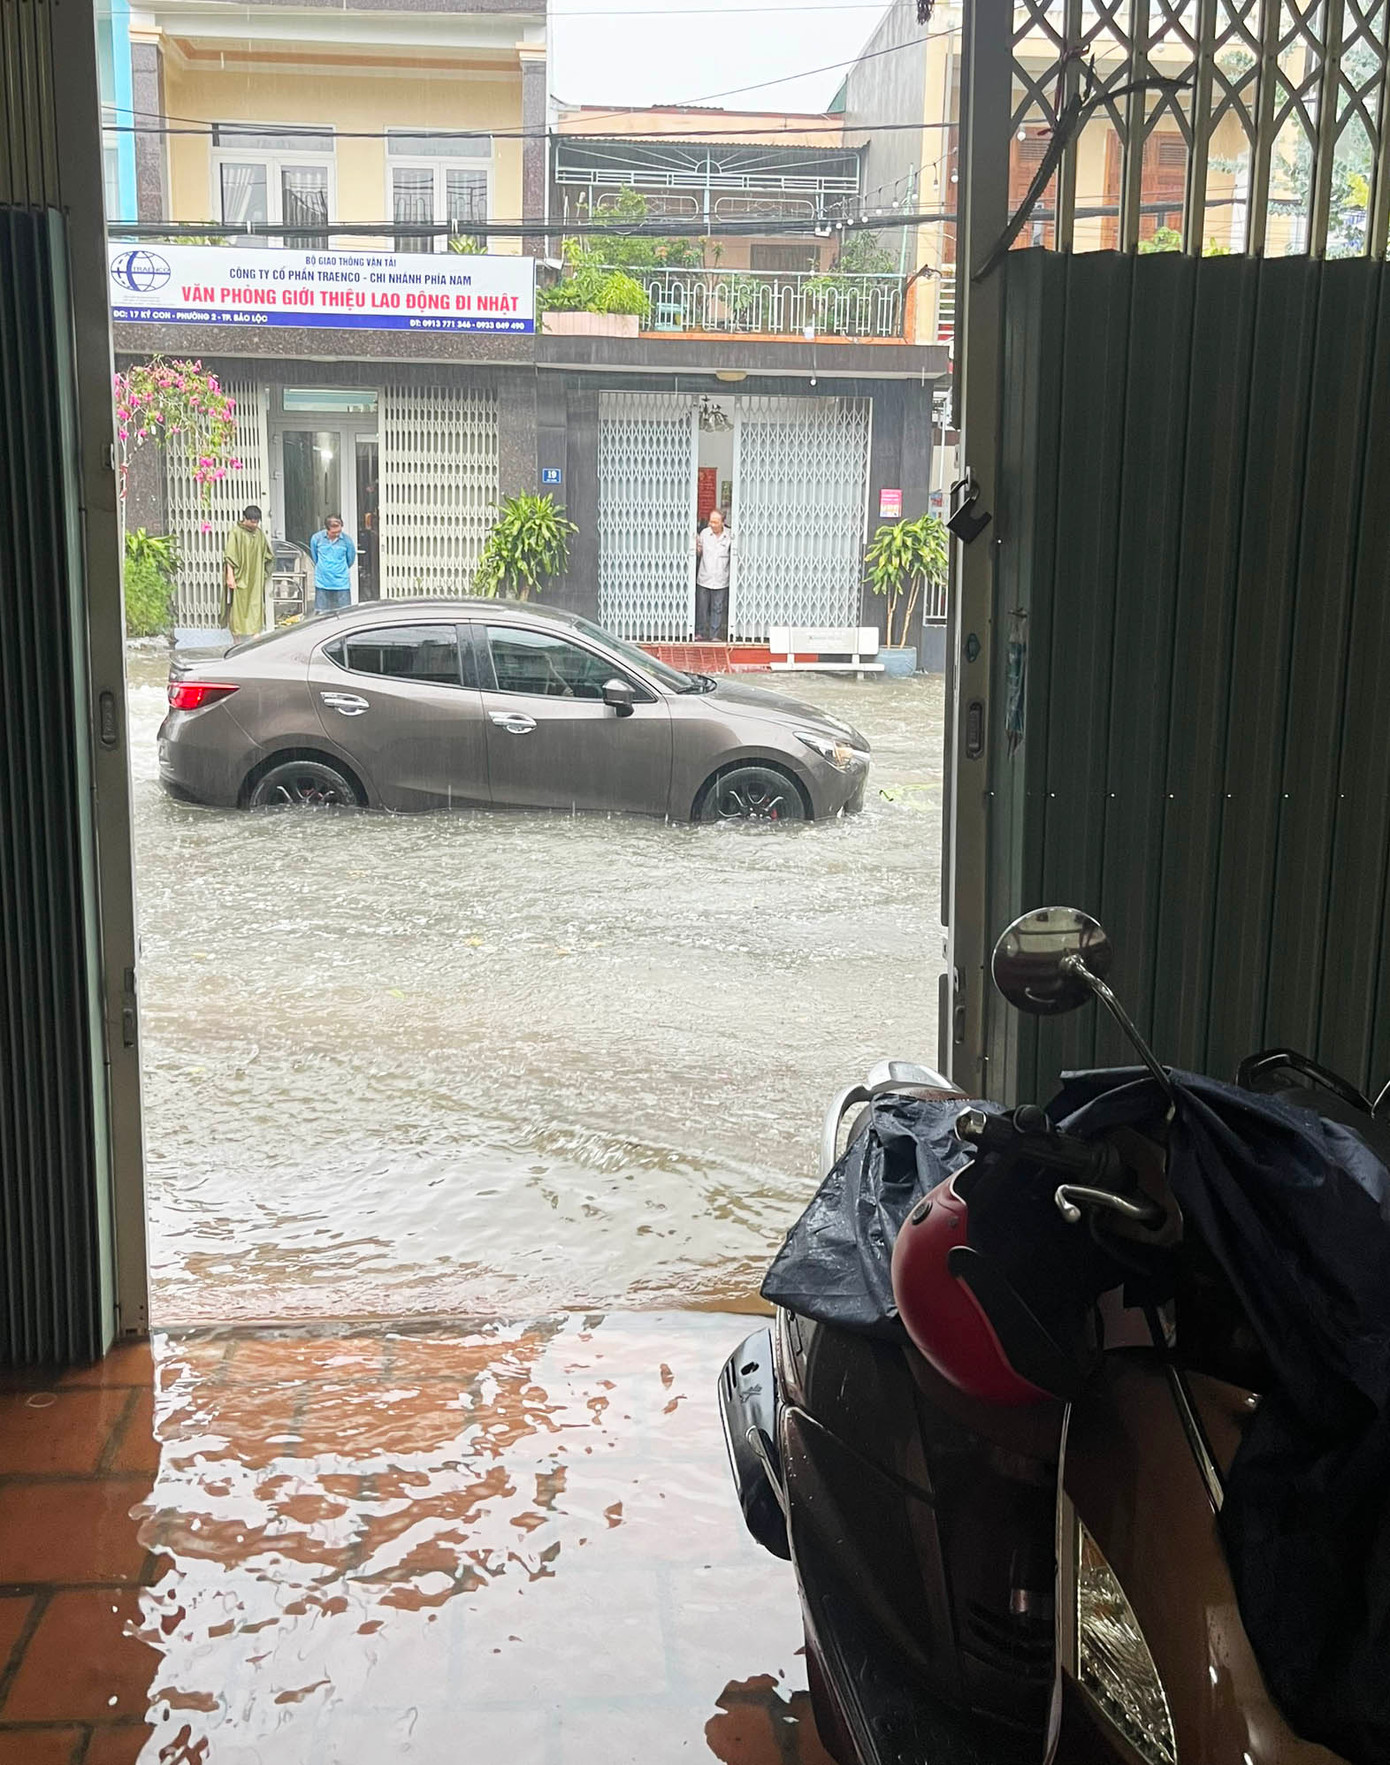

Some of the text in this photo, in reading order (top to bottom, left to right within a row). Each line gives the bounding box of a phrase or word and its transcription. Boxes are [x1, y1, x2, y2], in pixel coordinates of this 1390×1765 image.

[318, 256, 337, 266] GIAO
[339, 255, 364, 267] THÔNG
[229, 266, 256, 279] CÔNG
[259, 269, 270, 280] TY
[317, 271, 360, 284] TRAENCO
[369, 272, 386, 283] CHI
[388, 271, 422, 284] NHÁNH
[424, 273, 447, 285] PHÍA
[449, 275, 472, 286] NAM
[181, 283, 215, 303] VĂN
[220, 284, 277, 305] PHÒNG
[282, 286, 315, 306] GIỚI
[320, 288, 366, 311] THIỆU
[371, 292, 400, 308] LAO
[406, 290, 450, 313] ĐỘNG
[455, 295, 471, 311] ĐI
[477, 293, 519, 315] NHẬT
[129, 310, 139, 319] 17
[152, 311, 171, 320] CON
[547, 470, 557, 479] 19
